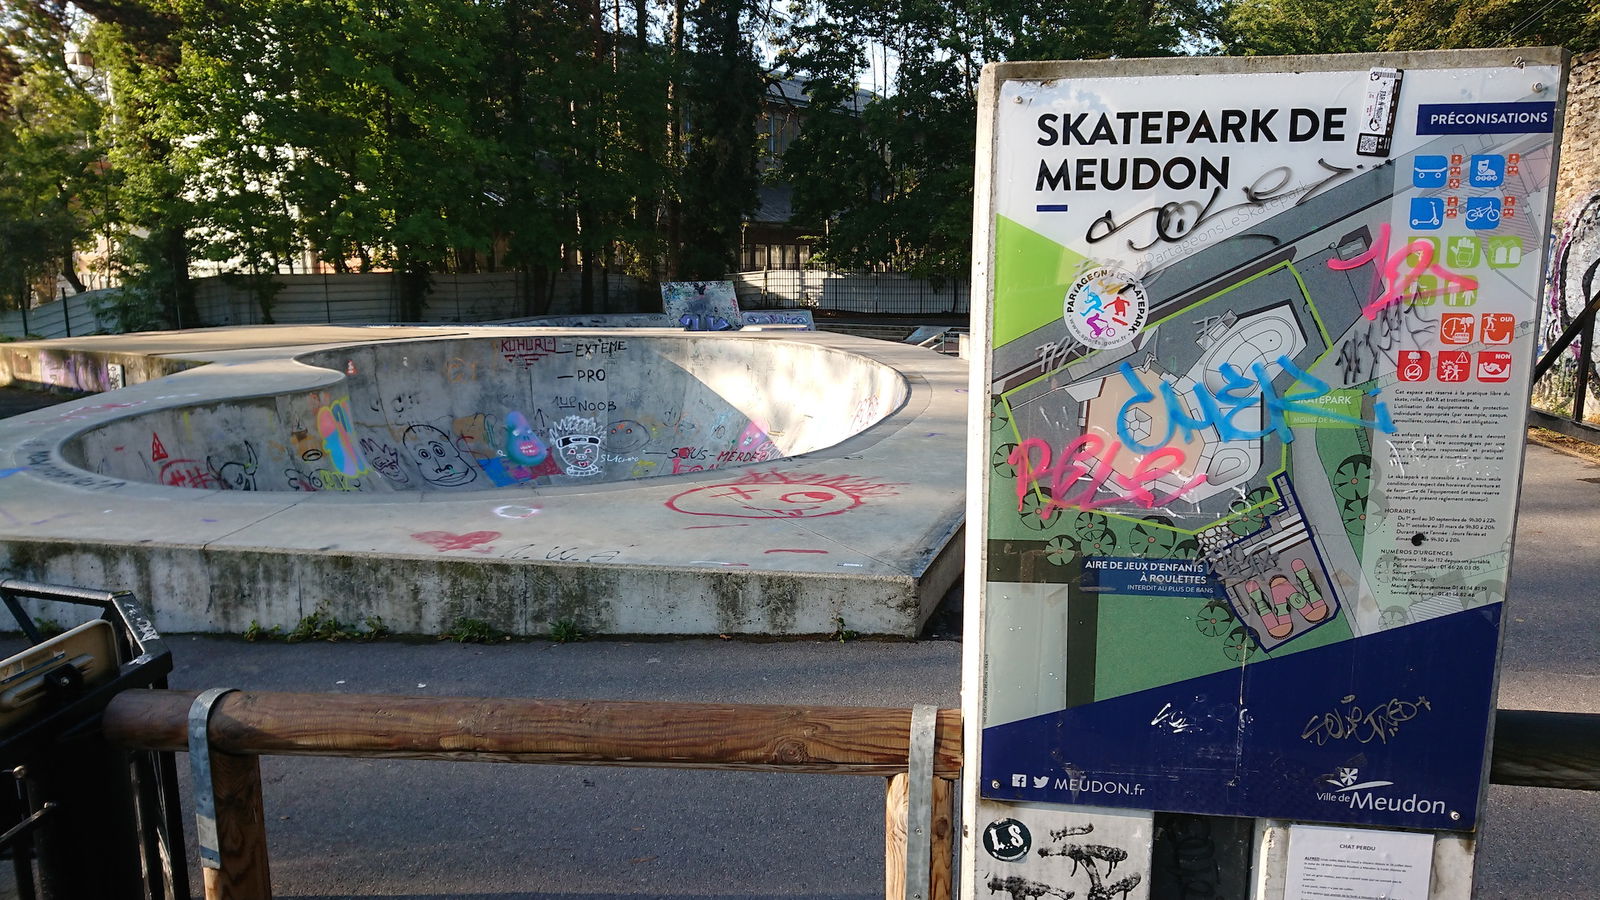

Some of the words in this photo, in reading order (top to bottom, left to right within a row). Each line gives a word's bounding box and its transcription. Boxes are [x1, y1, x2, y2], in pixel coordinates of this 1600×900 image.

[1430, 111, 1548, 125] PRÉCONISATIONS
[1037, 109, 1279, 146] SKATEPARK
[1288, 107, 1347, 142] DE
[1035, 156, 1230, 191] MEUDON
[578, 368, 606, 382] PRO
[578, 400, 617, 412] NOOB
[1085, 560, 1107, 570] AIRE
[1110, 562, 1122, 570] DE
[1124, 562, 1148, 571] JEUX
[1150, 562, 1204, 573] D'ENFANTS
[1140, 572, 1147, 582] À
[1150, 574, 1207, 584] ROULETTES
[1054, 778, 1145, 796] MEUDON.fr
[1316, 792, 1336, 802] Ville
[1338, 794, 1350, 802] de
[1350, 792, 1446, 814] Meudon
